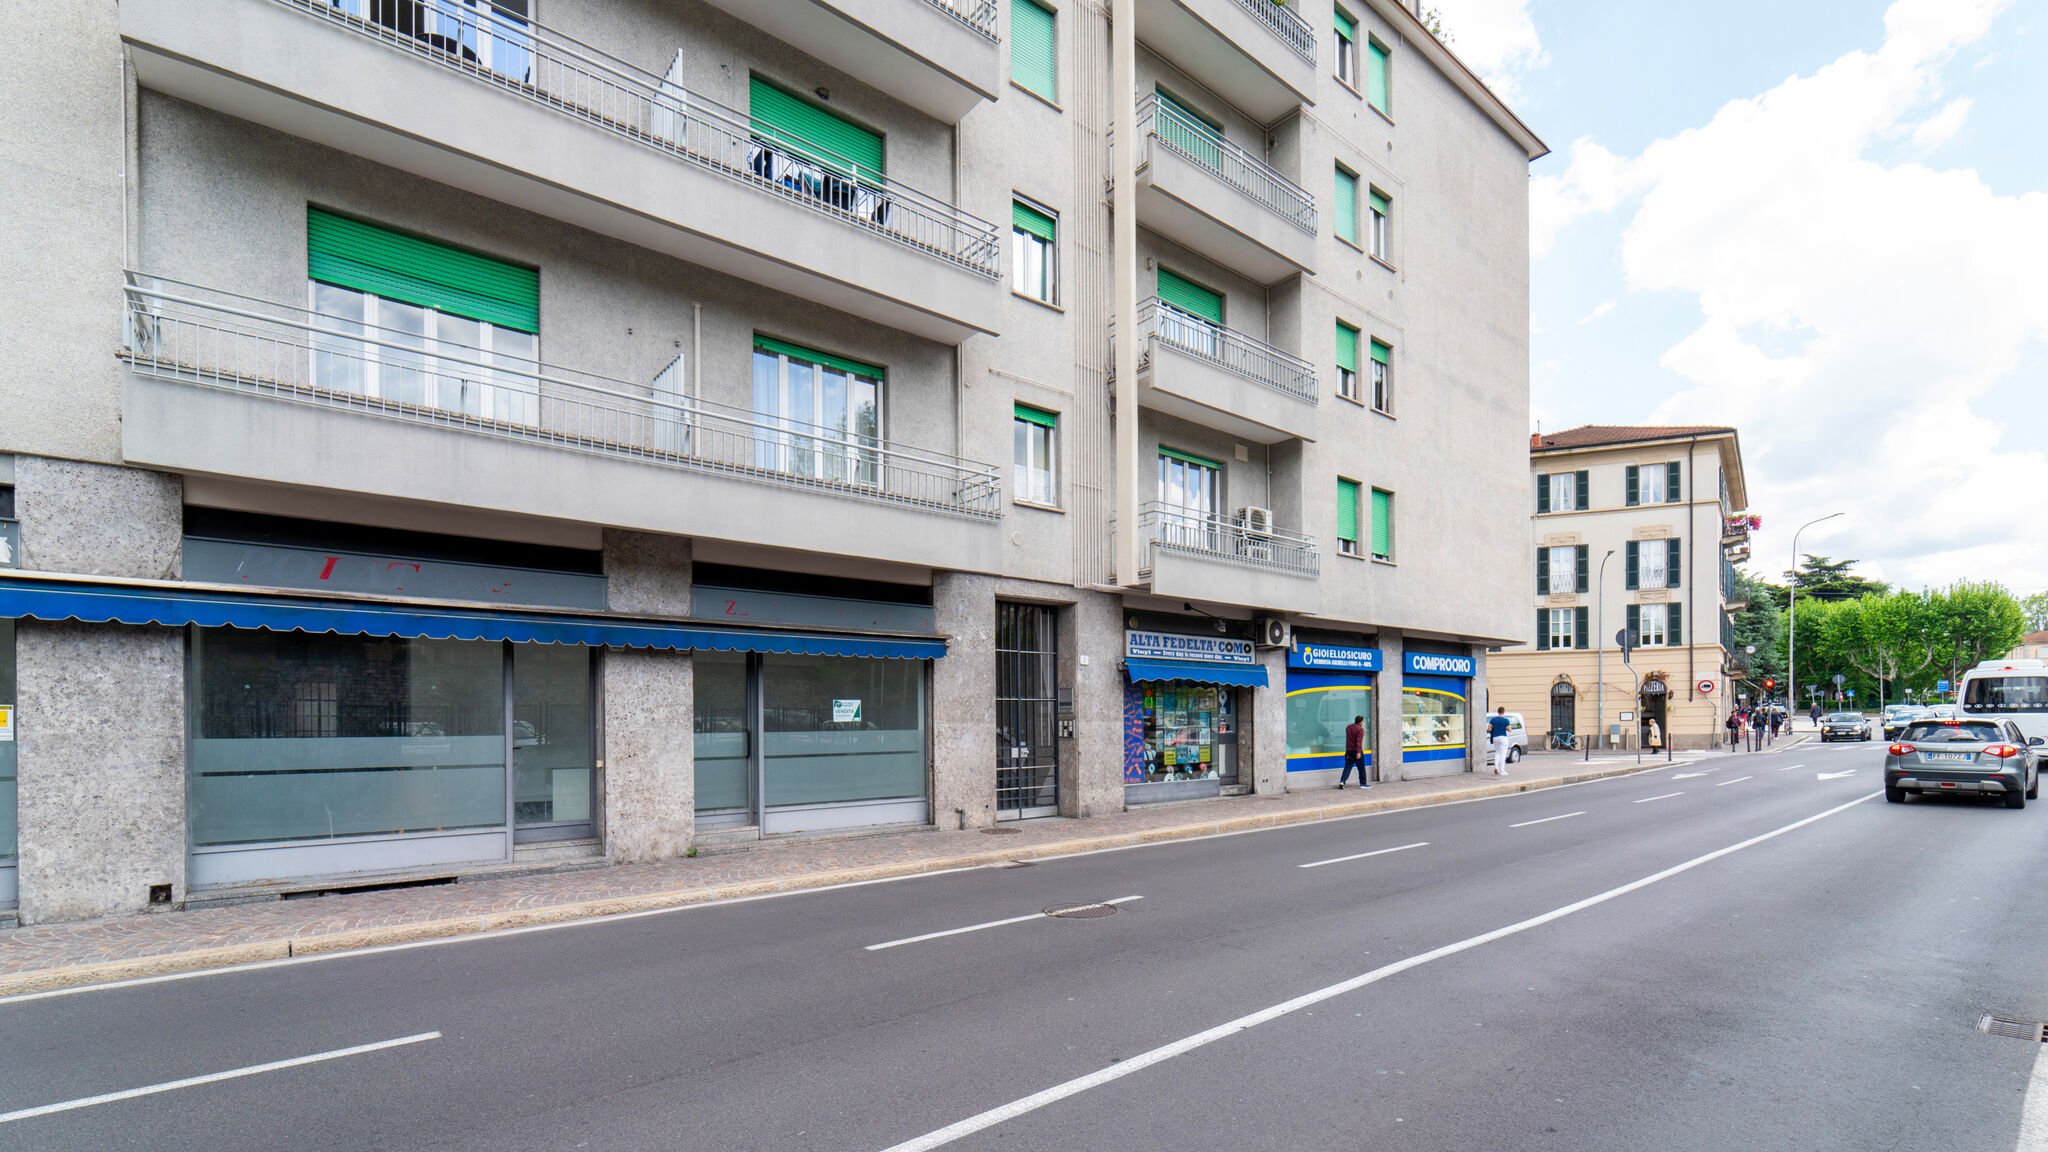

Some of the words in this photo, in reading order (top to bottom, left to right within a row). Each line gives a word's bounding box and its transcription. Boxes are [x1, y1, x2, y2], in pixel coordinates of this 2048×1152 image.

[1130, 634, 1160, 647] ALTA
[1162, 637, 1216, 651] FEDELTA'
[1218, 641, 1251, 654] COMO
[1413, 656, 1470, 672] COMPROORO
